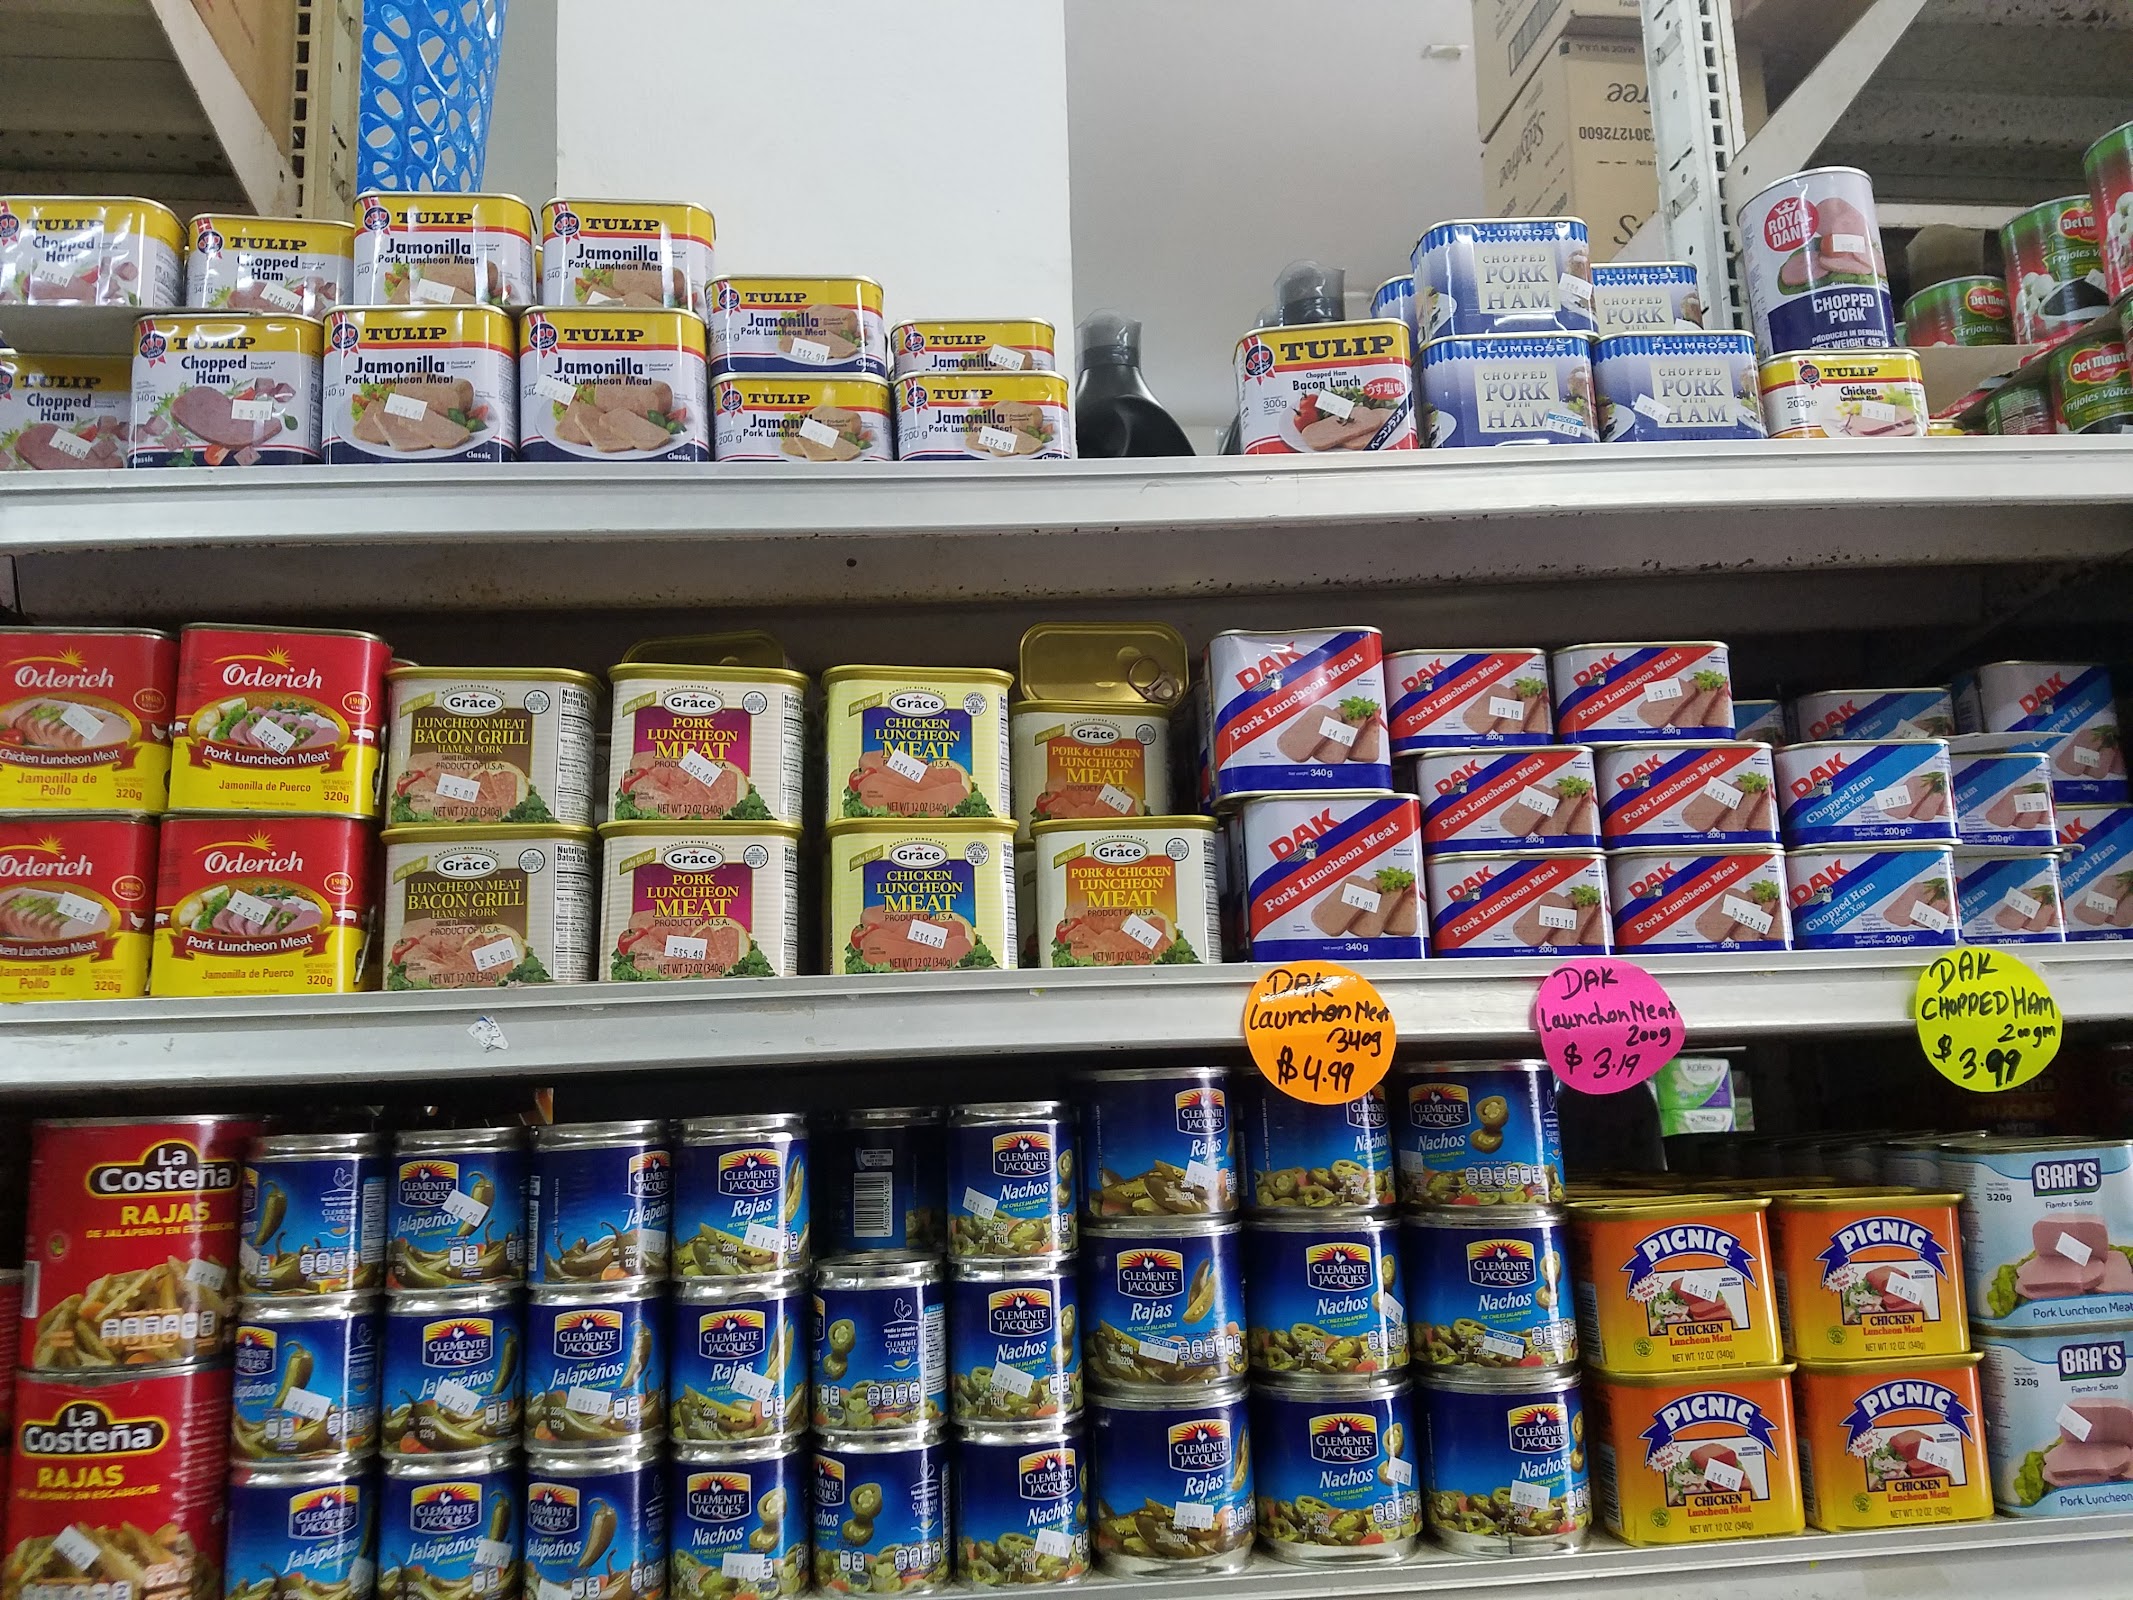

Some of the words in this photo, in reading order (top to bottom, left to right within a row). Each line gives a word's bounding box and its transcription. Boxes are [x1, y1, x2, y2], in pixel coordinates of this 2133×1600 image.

[397, 212, 472, 224] TULIP
[1772, 223, 1811, 248] DANE
[230, 237, 306, 250] TULIP
[386, 239, 471, 254] Jamonilla
[237, 256, 298, 270] Chopped
[1482, 255, 1546, 263] CHOPPED
[251, 269, 283, 281] Ham
[1485, 264, 1549, 284] PORK
[746, 292, 807, 303] TULIP
[1487, 291, 1551, 309] HAM
[1813, 294, 1875, 314] CHOPPED
[748, 313, 819, 328] Jamonilla
[1829, 308, 1867, 323] PORK
[366, 327, 447, 340] TULIP
[564, 328, 644, 342] TULIP
[741, 327, 761, 336] Pork
[763, 328, 802, 337] Luncheon
[805, 328, 827, 336] Meat
[174, 337, 255, 349] TULIP
[1281, 336, 1394, 361] TULIP
[1477, 344, 1566, 353] PLUMROSE
[1652, 342, 1739, 350] PLUMROSE
[181, 356, 247, 371] Chopped
[354, 356, 445, 374] Jamonilla
[554, 357, 643, 375] Jamonilla
[2073, 360, 2091, 375] Del
[2091, 352, 2128, 369] Mont
[196, 371, 230, 384] Ham
[345, 374, 371, 385] Pork
[374, 375, 429, 385] Luncheon
[432, 375, 453, 384] Meat
[1306, 371, 1330, 380] Chopped
[1332, 370, 1347, 378] Ham
[1482, 371, 1546, 381] CHOPPED
[1824, 366, 1879, 379] TULIP
[1293, 378, 1326, 391] Bacon
[1329, 375, 1361, 388] Lunch
[1366, 381, 1405, 396] うす塩味
[934, 389, 992, 400] TULIP
[1486, 382, 1550, 401] PORK
[1841, 386, 1877, 396] Chicken
[1263, 399, 1287, 409] 300g
[2066, 392, 2099, 413] Frijoles
[935, 409, 1005, 424] Jamonilla
[466, 451, 491, 460] Classic
[1235, 642, 1304, 691] DAK
[15, 666, 114, 688] Oderich
[222, 663, 322, 689] Oderich
[450, 696, 497, 711] Grace
[671, 696, 716, 709] Grace
[895, 697, 939, 710] Grace
[1230, 718, 1261, 741] Pork
[1262, 674, 1329, 722] Luncheon
[1327, 652, 1364, 680] Meat
[416, 717, 488, 730] LUNCHEON
[491, 718, 527, 730] MEAT
[673, 718, 714, 729] PORK
[885, 718, 950, 729] CHICKEN
[415, 730, 472, 745] BACON
[476, 730, 529, 745] GRILL
[647, 729, 738, 742] LUNCHEON
[875, 729, 961, 741] LUNCHEON
[204, 747, 231, 762] Pork
[234, 752, 294, 766] Luncheon
[298, 750, 330, 763] Meat
[17, 773, 78, 785] Jamonilla
[81, 773, 97, 784] de
[1310, 768, 1333, 779] 340g
[1791, 753, 1850, 799] DAK
[41, 785, 71, 796] Pollo
[219, 780, 262, 791] Jamonilla
[265, 782, 277, 791] de
[279, 782, 311, 792] Puerco
[116, 789, 142, 801] 320g
[1806, 790, 1852, 825] Chopped
[1849, 774, 1875, 795] Ham
[671, 852, 717, 866] Grace
[1071, 867, 1103, 878] PORK
[1106, 867, 1114, 878] &
[1116, 866, 1171, 878] CHICKEN
[1079, 878, 1163, 890] LUNCHEON
[1087, 891, 1157, 908] MEAT
[654, 899, 732, 917] MEAT
[1930, 952, 1998, 993] DAK
[1266, 969, 1333, 999] DAK
[1561, 967, 1618, 1000] DAK
[1921, 992, 2010, 1022] CHOPPED
[2012, 985, 2056, 1019] HAM
[1354, 1002, 1390, 1023] Meat
[1630, 1002, 1677, 1026] Meat
[1326, 1029, 1381, 1056] 340g
[1626, 1027, 1671, 1048] 200g
[1564, 1042, 1582, 1072] $
[1594, 1049, 1640, 1080] 3.19
[1934, 1034, 1952, 1062] $
[1960, 1049, 2023, 1088] 3.99
[1277, 1046, 1297, 1085] $
[1304, 1059, 1354, 1094] 4.99
[157, 1148, 188, 1166] La
[998, 1152, 1049, 1164] CLEMENTE
[723, 1168, 778, 1182] CLEMENTE
[1003, 1162, 1047, 1173] JACQUES
[2036, 1161, 2098, 1189] BRA'S
[99, 1164, 232, 1192] Costeña
[729, 1178, 777, 1192] JACQUES
[1000, 1180, 1049, 1201] Nachos
[1987, 1193, 2012, 1203] 320g
[730, 1197, 772, 1218] Rajas
[2046, 1201, 2072, 1209] Fiambre
[2074, 1200, 2093, 1208] Suino
[121, 1202, 210, 1225] RAJAS
[1839, 1220, 1926, 1254] PICNIC
[1641, 1228, 1733, 1262] PICNIC
[1122, 1271, 1178, 1283] CLEMENTE
[1313, 1264, 1368, 1275] CLEMENTE
[1127, 1281, 1175, 1294] JACQUES
[1318, 1274, 1365, 1286] JACQUES
[1131, 1300, 1173, 1325] Rajas
[1315, 1296, 1368, 1317] Nachos
[2033, 1308, 2056, 1319] Pork
[2058, 1305, 2107, 1317] Luncheon
[559, 1330, 616, 1344] CLEMENTE
[1676, 1323, 1723, 1336] CHICKEN
[564, 1340, 614, 1355] JACQUES
[1670, 1335, 1710, 1347] Luncheon
[1712, 1333, 1732, 1343] Meat
[1672, 1353, 1684, 1362] NET
[1698, 1351, 1706, 1360] 12
[1707, 1351, 1715, 1360] OZ
[1717, 1350, 1735, 1362] (340g)
[2062, 1344, 2122, 1373] BRA'S
[549, 1362, 624, 1390] Jalapeños
[1861, 1383, 1952, 1417] PICNIC
[67, 1407, 98, 1427] La
[1664, 1396, 1755, 1429] PICNIC
[24, 1423, 153, 1453] Costeña
[37, 1465, 125, 1488] RAJAS
